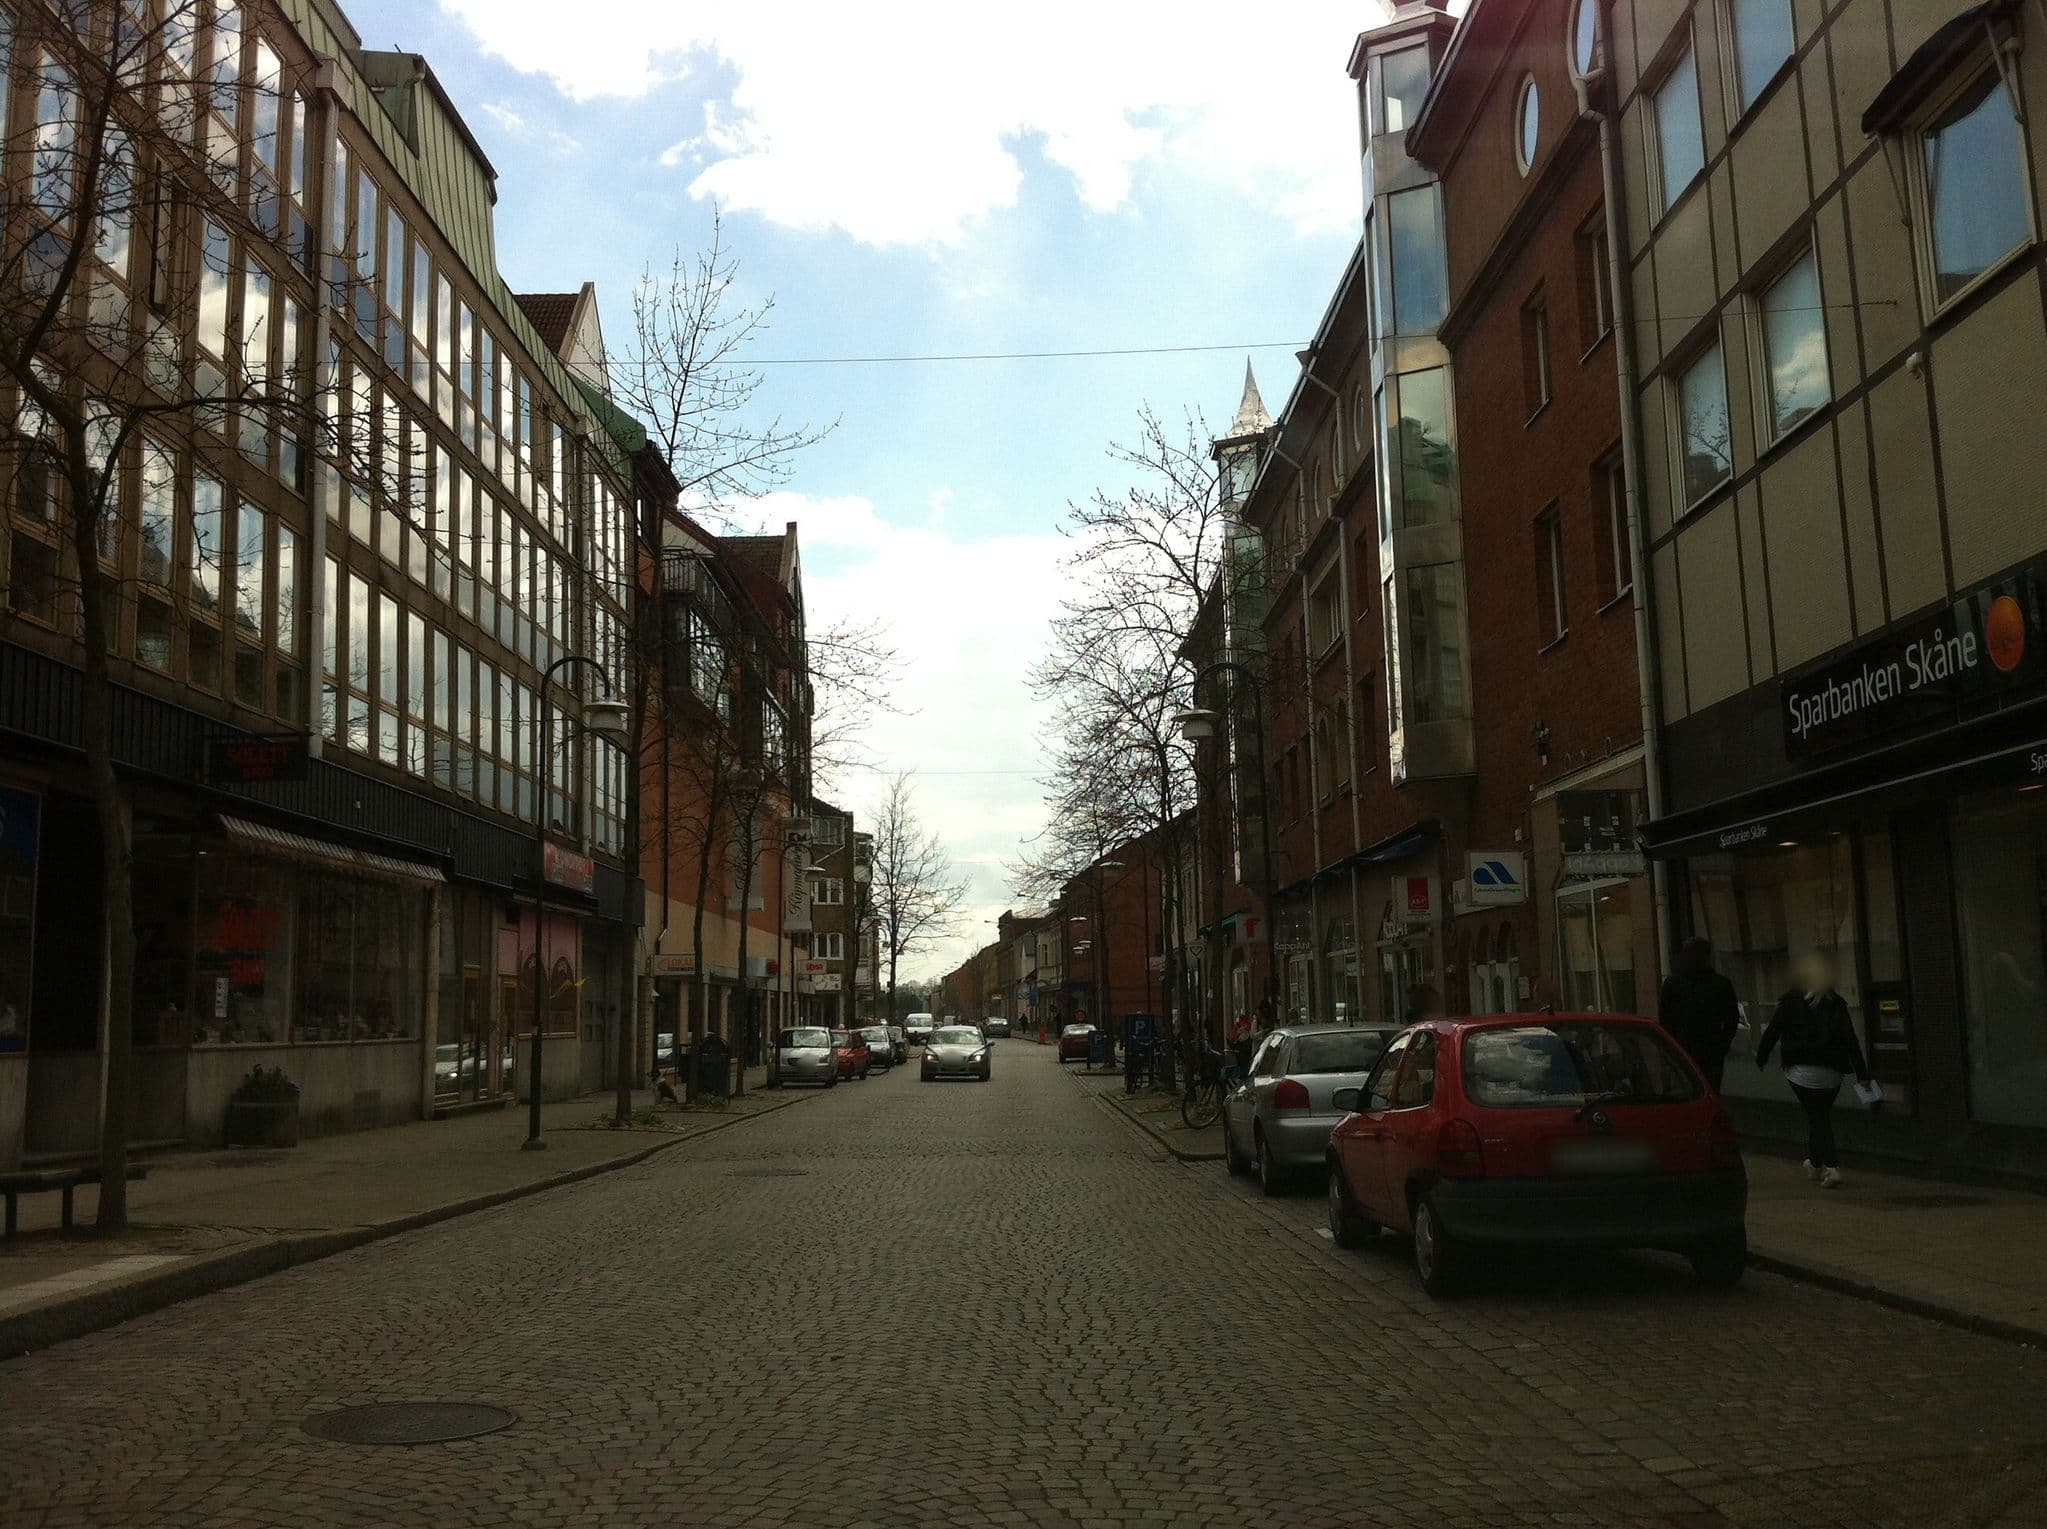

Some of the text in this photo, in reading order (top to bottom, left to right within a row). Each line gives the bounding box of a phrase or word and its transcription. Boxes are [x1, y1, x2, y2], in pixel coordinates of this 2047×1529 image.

[1788, 628, 1978, 739] Sparbanken Skåne
[1136, 1020, 1146, 1034] P
